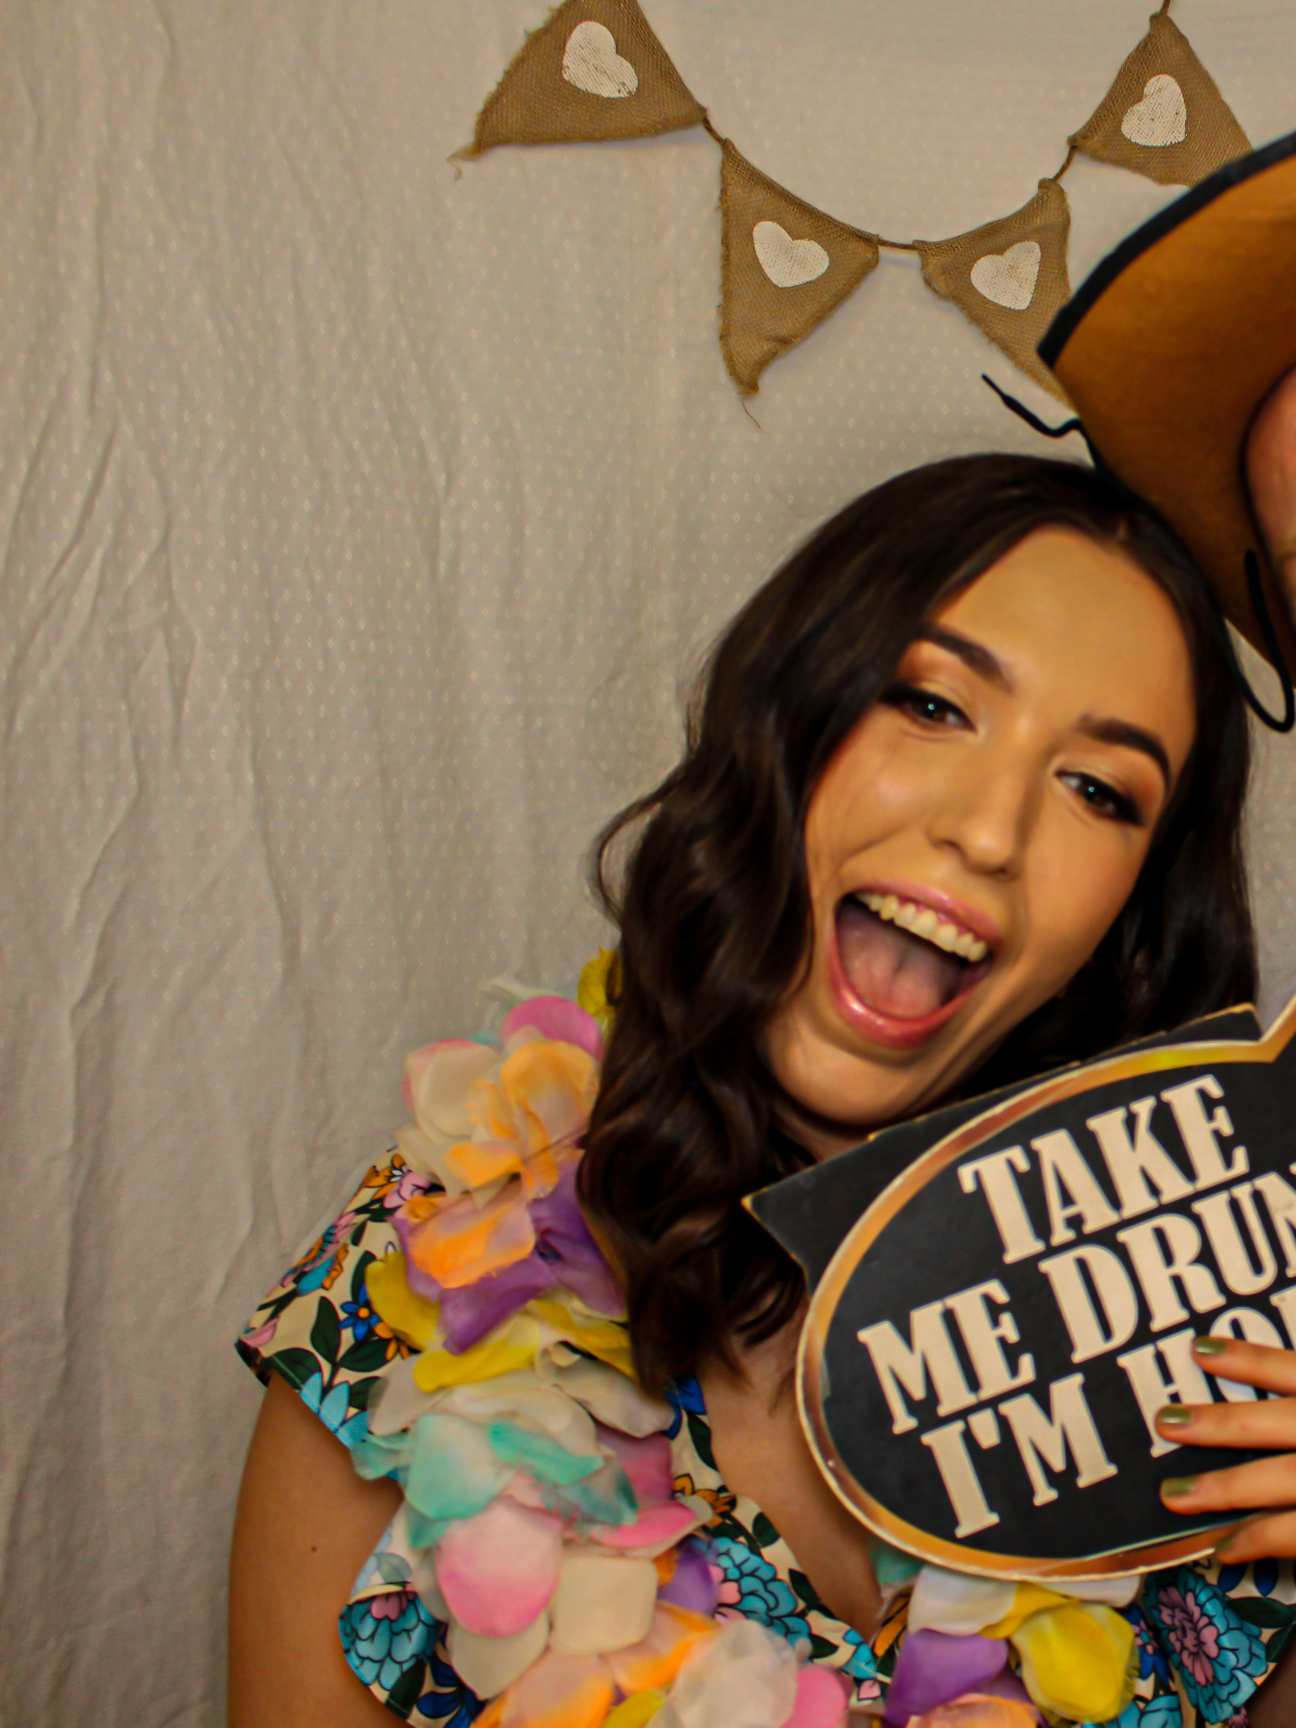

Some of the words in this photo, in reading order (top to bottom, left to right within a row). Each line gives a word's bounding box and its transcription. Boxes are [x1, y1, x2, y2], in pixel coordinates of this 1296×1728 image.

[958, 1074, 1249, 1264] TAKE
[857, 1279, 1036, 1435] ME
[921, 1373, 1117, 1538] I'M
